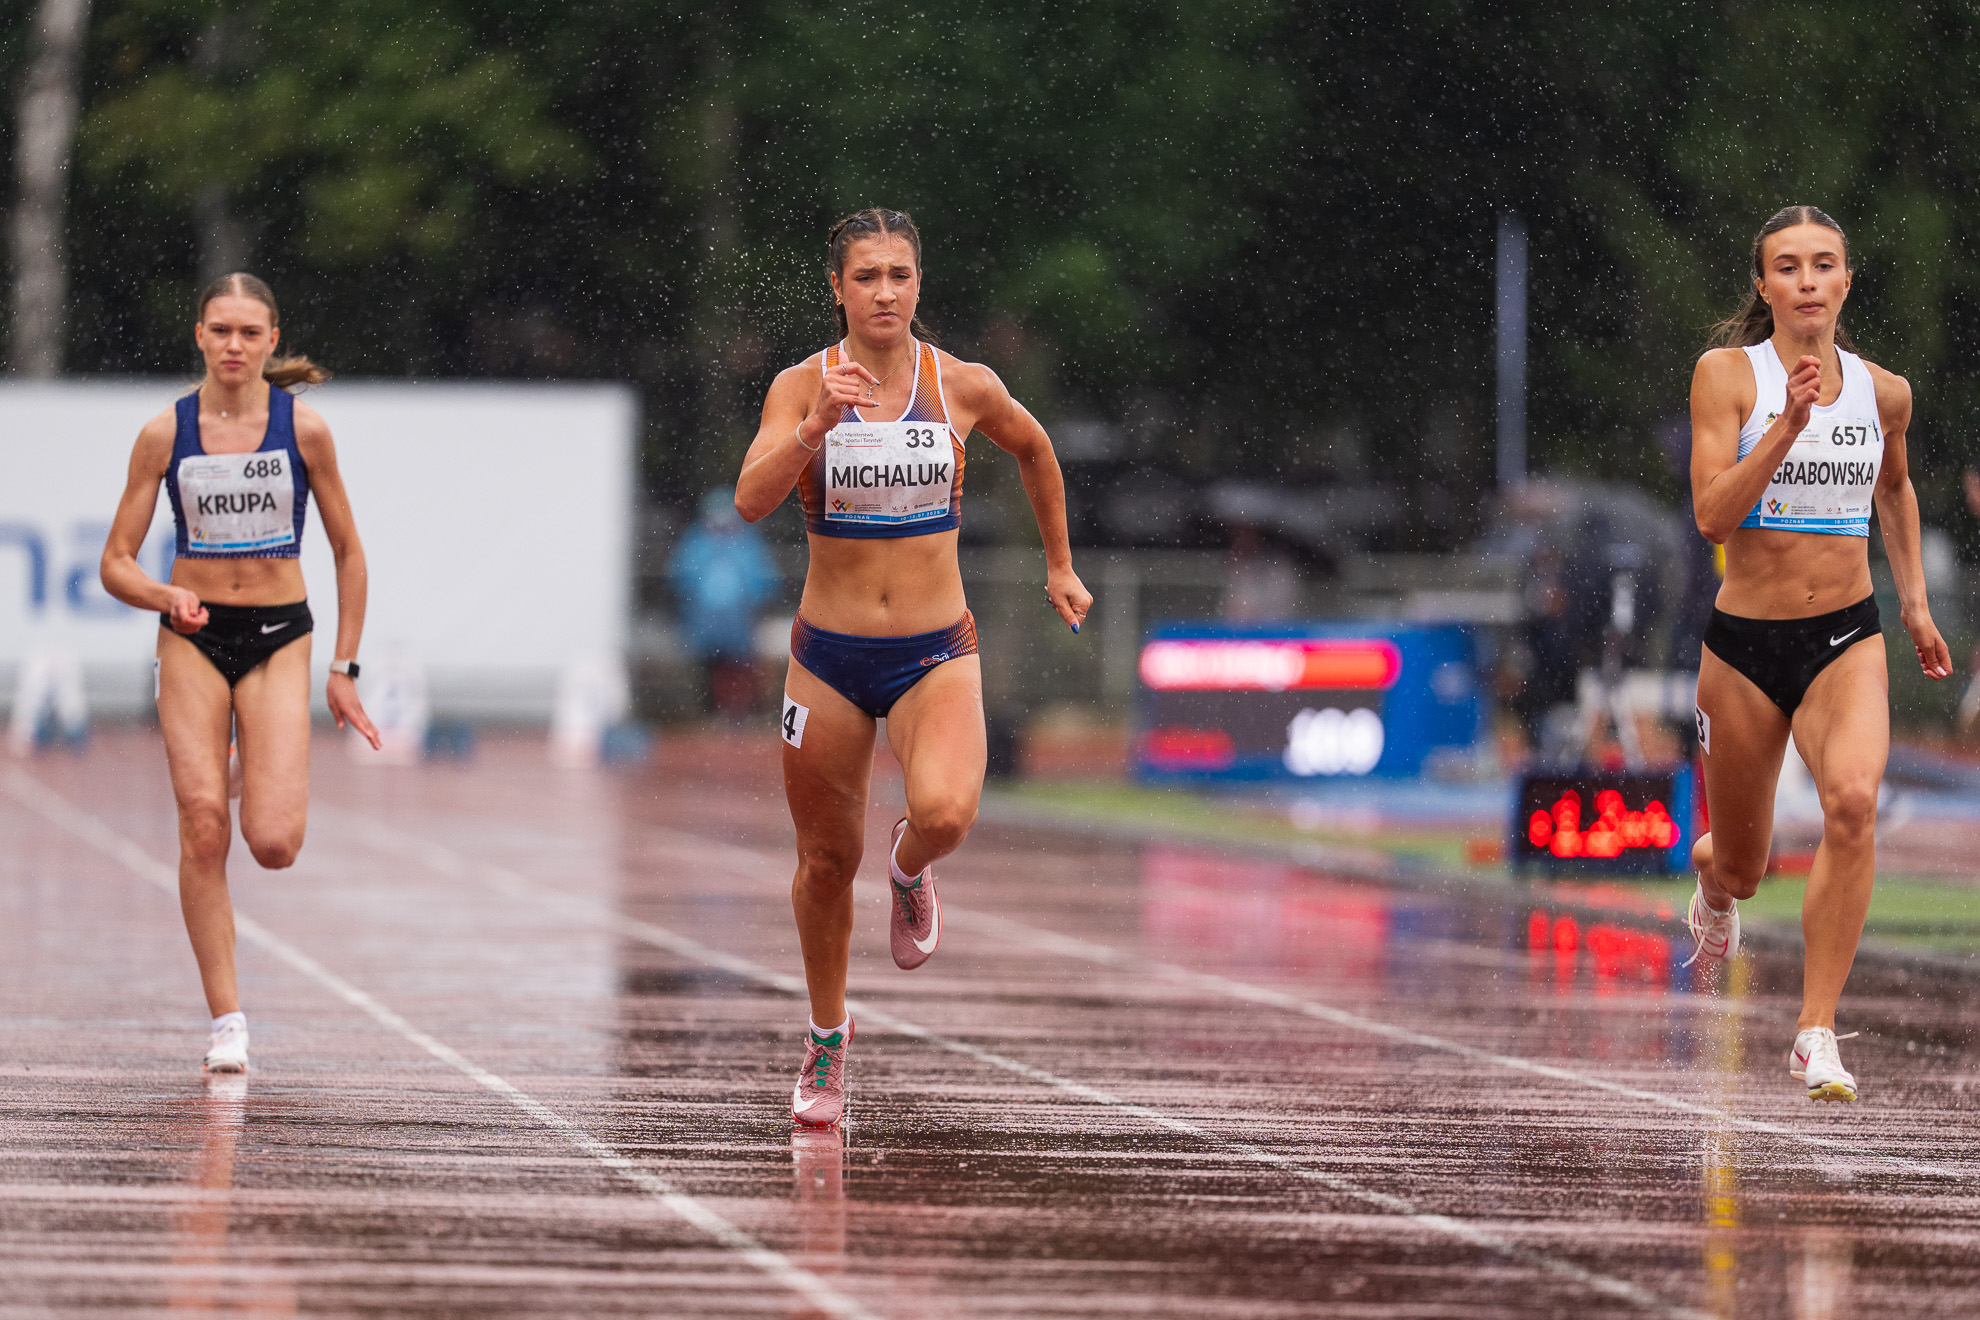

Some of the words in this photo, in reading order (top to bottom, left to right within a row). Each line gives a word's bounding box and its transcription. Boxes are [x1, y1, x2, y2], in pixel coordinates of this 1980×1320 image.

[905, 428, 935, 448] 33
[1831, 425, 1867, 446] 657
[243, 458, 282, 479] 688
[831, 462, 949, 489] MICHALUK
[197, 491, 277, 516] KRUPA
[783, 704, 798, 742] 4
[1696, 706, 1706, 743] 3
